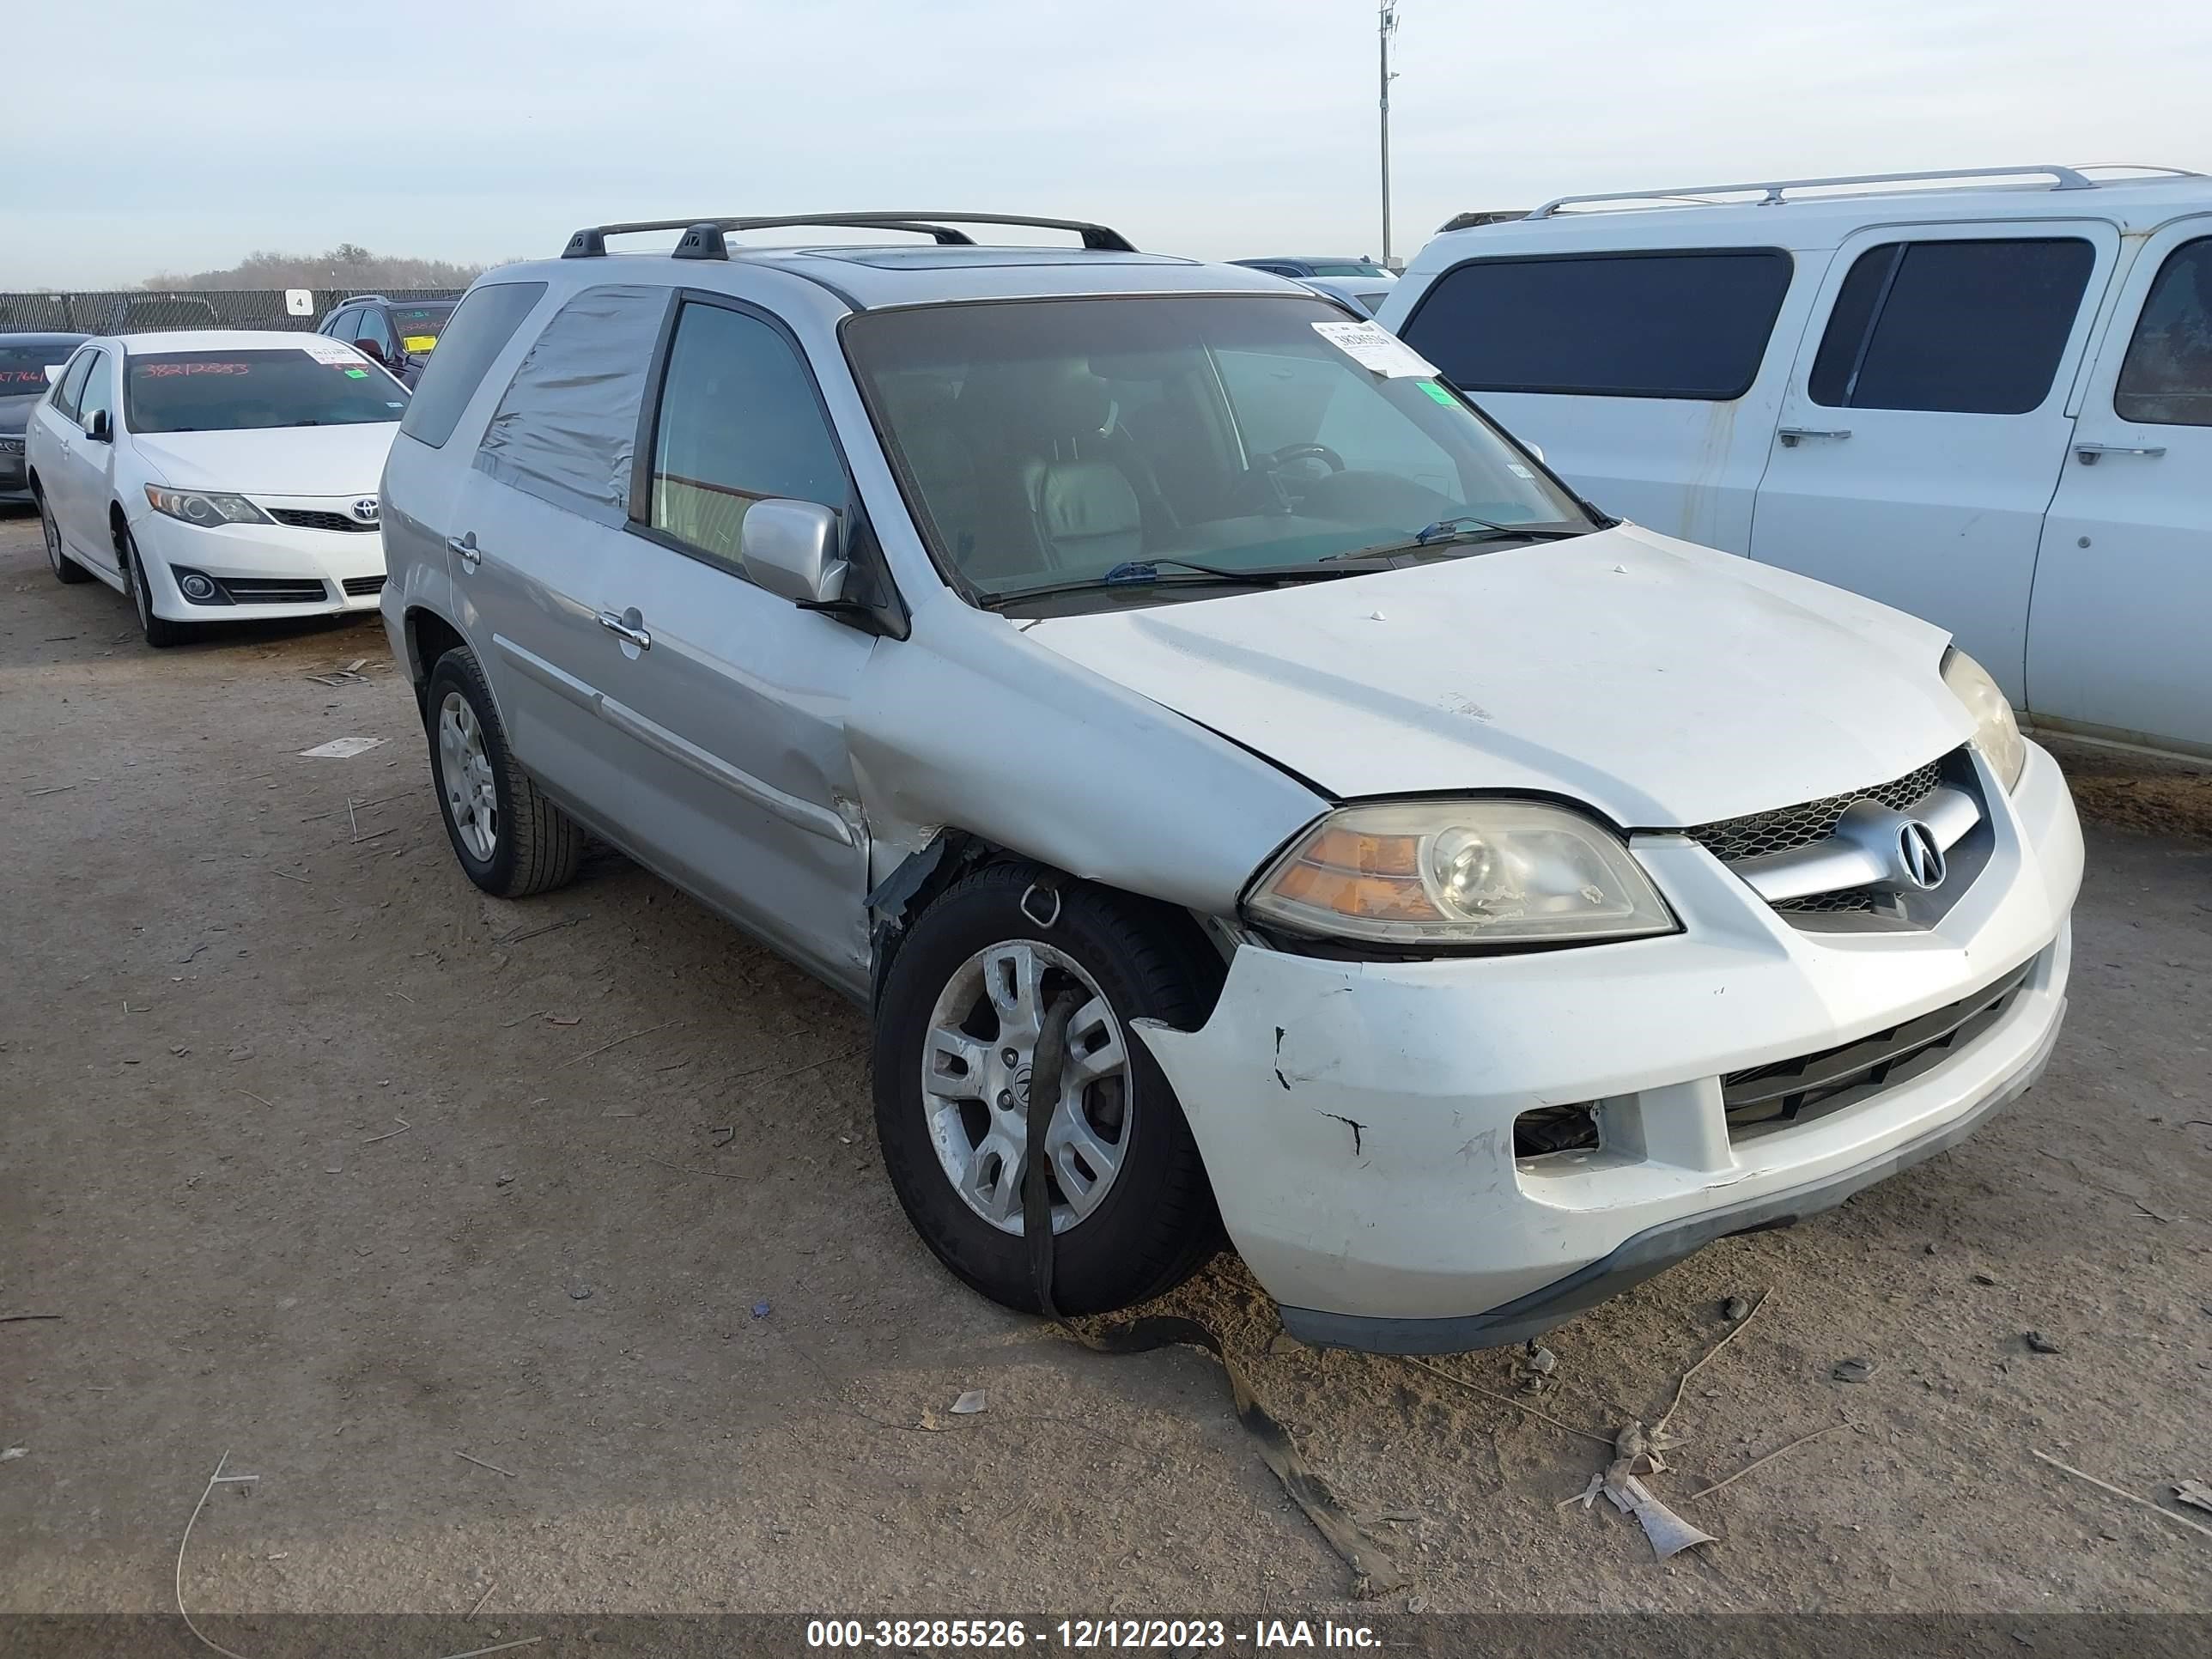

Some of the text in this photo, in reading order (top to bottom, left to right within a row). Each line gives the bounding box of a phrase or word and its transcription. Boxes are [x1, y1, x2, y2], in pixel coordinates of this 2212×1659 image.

[296, 298, 303, 307] 4
[1334, 334, 1391, 346] 38285526
[141, 362, 250, 379] 38212883
